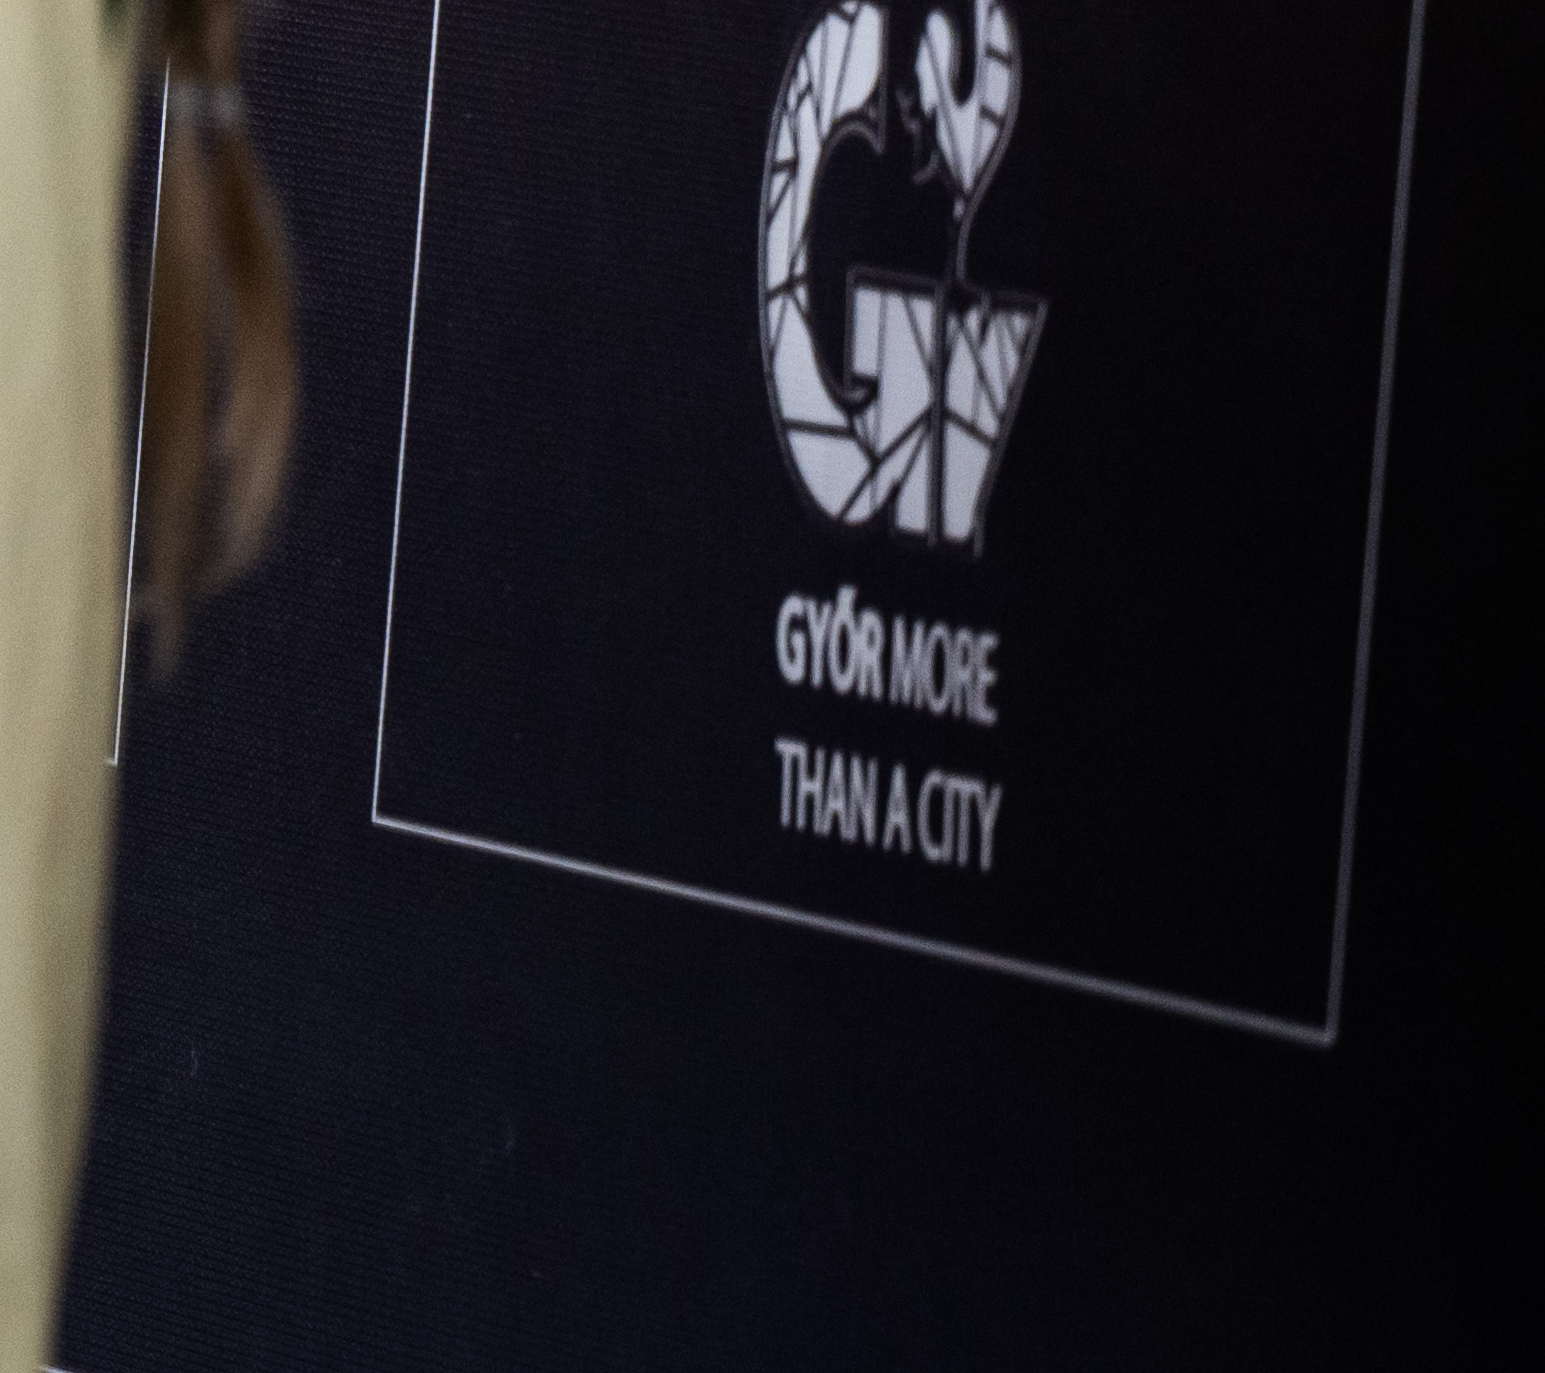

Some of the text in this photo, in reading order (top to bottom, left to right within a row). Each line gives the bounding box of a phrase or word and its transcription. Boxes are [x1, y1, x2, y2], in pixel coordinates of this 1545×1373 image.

[889, 613, 999, 727] MORE
[774, 737, 1003, 875] THAN A CITY
